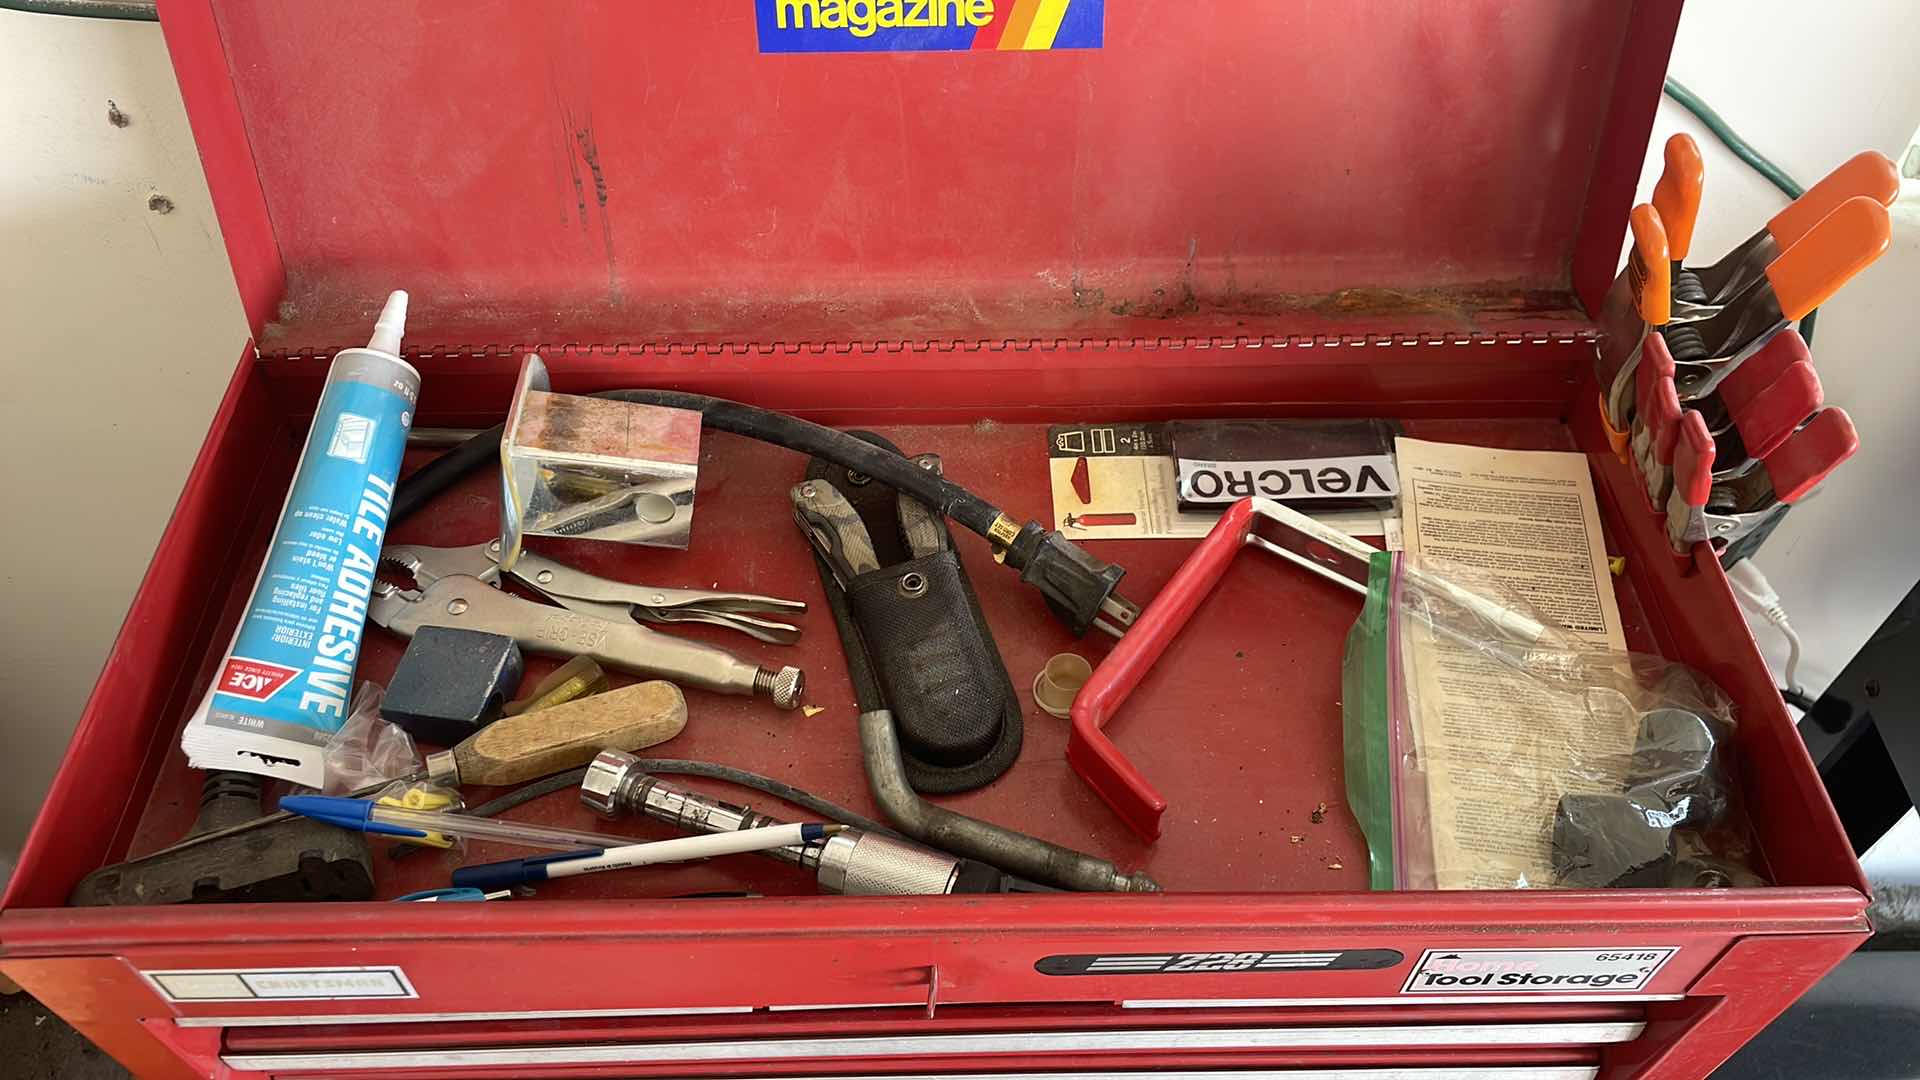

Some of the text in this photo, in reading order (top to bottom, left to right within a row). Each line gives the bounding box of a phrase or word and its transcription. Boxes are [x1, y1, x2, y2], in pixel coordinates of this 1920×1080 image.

[775, 0, 996, 38] magazine
[352, 473, 395, 546] TILE
[325, 514, 348, 528] Water
[327, 534, 343, 546] Low
[292, 554, 334, 572] Won't stain
[305, 550, 337, 563] or bleed
[291, 582, 309, 593] tiles
[308, 587, 327, 599] floor
[271, 587, 324, 605] and replacing
[272, 596, 322, 615] For installing
[275, 624, 314, 640] EXTERIOR
[299, 543, 377, 718] ADHESIVE
[1575, 624, 1604, 632] LIMITED
[228, 671, 274, 693] ACE
[237, 715, 265, 729] WHITE
[1163, 952, 1264, 972] Z28
[1595, 952, 1658, 962] 65418
[256, 977, 387, 990] CRAFTSMAN
[1424, 970, 1639, 988] Tool Storage
